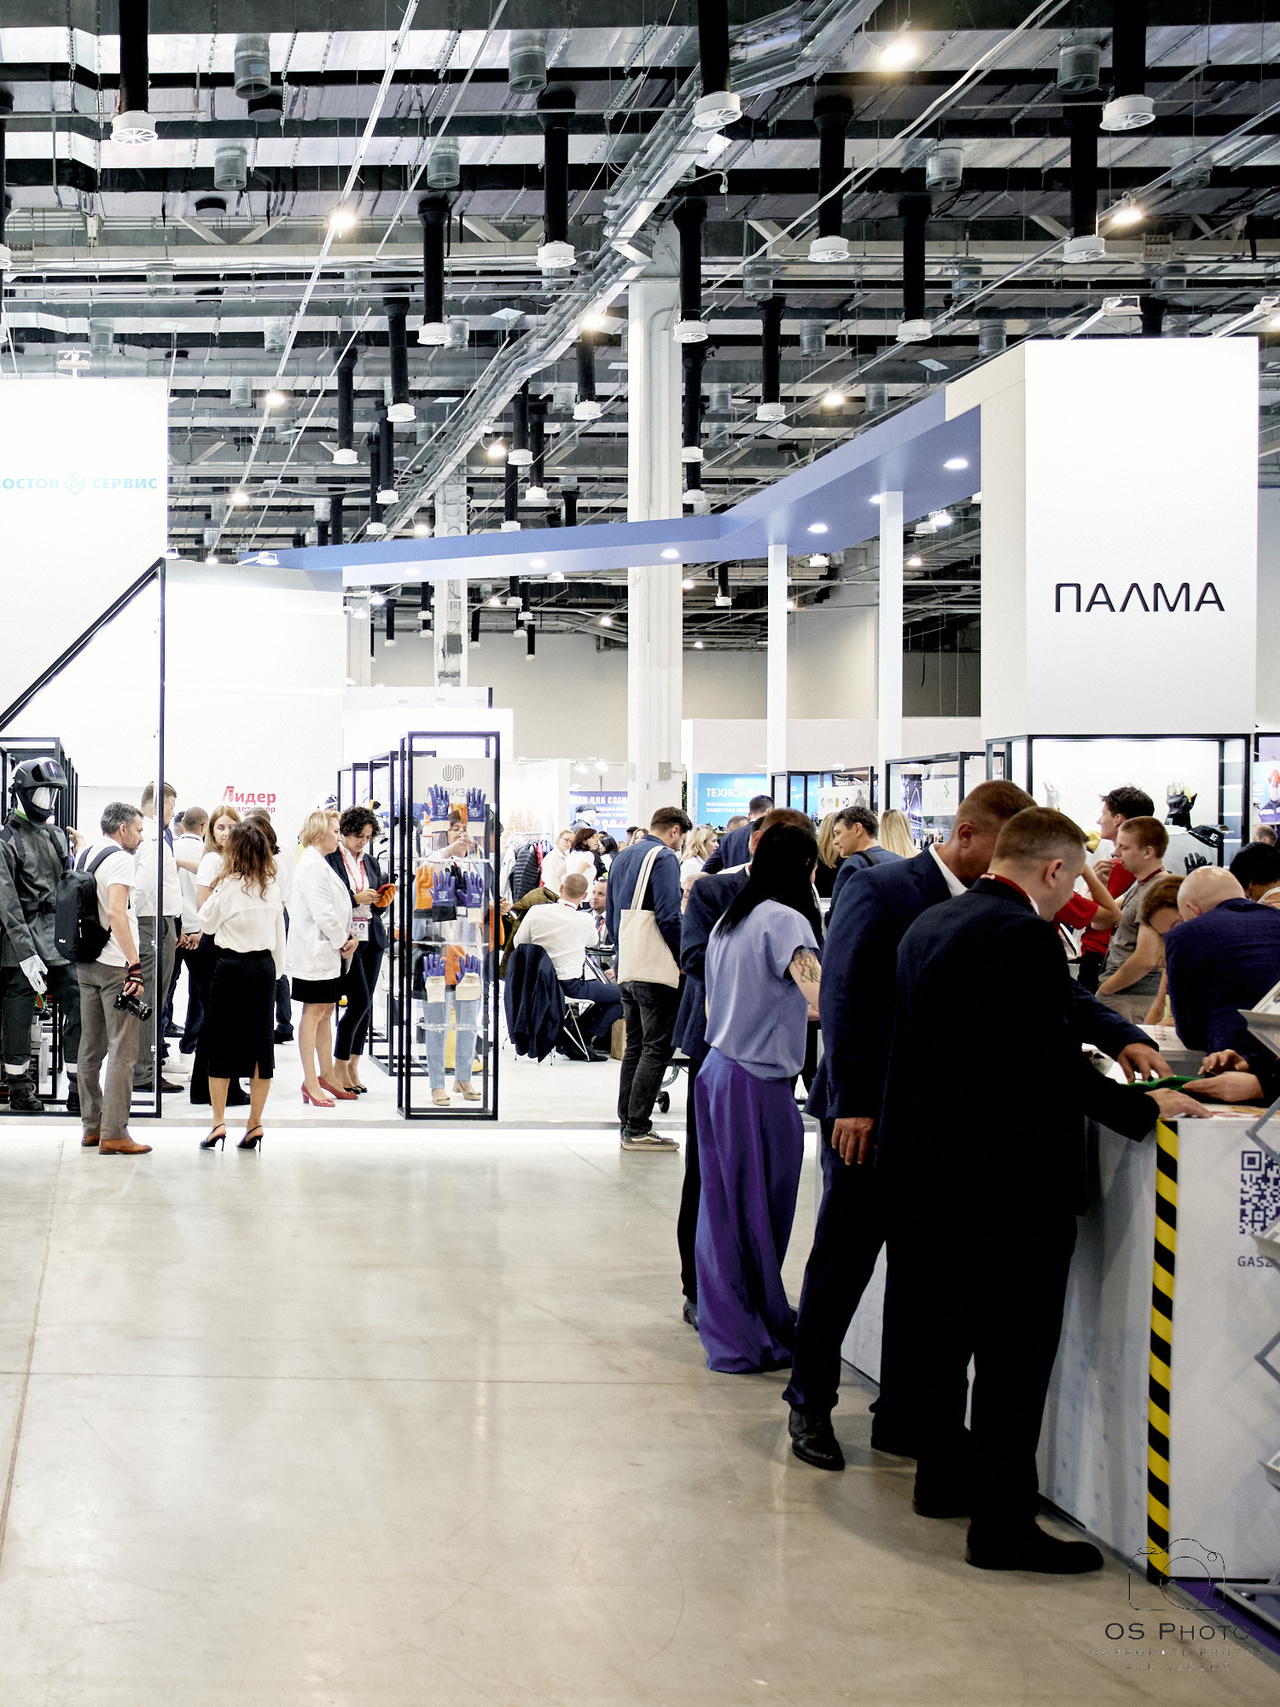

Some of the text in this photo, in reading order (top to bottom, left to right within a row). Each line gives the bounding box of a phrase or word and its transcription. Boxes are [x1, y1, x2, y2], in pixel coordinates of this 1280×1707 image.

[92, 478, 157, 490] СЕРВИС
[1055, 582, 1225, 612] ПАЛМА
[221, 785, 277, 806] Лидер
